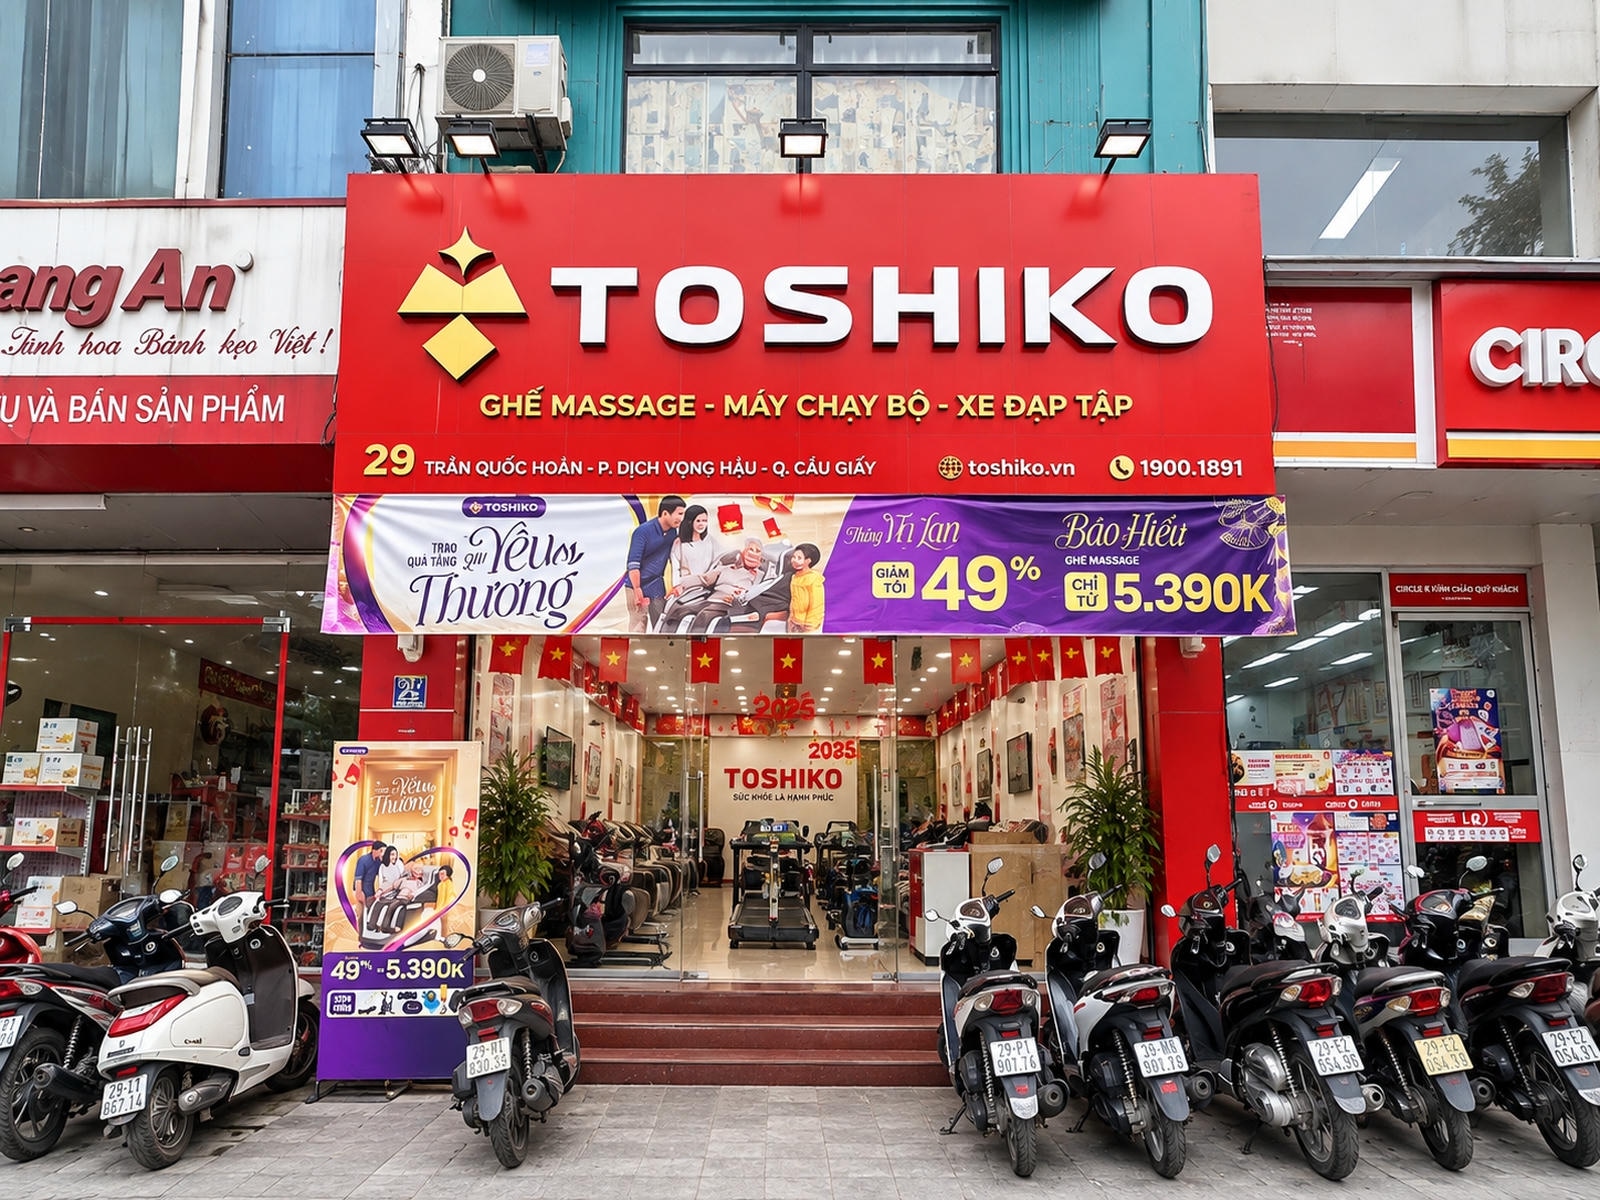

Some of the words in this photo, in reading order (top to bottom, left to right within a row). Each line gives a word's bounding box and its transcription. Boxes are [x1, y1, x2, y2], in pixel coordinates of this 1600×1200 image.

[120, 247, 236, 312] An
[549, 265, 1214, 351] TOSHIKO
[78, 331, 122, 356] hoa
[134, 327, 206, 356] Bánh
[219, 328, 258, 360] kẹo
[27, 387, 60, 423] VÀ
[68, 387, 128, 423] BÁN
[135, 386, 193, 423] SẢN
[201, 384, 285, 423] PHẨM
[480, 385, 545, 417] GHẾ
[551, 393, 696, 417] MASSAGE
[724, 389, 788, 417] MÁY
[797, 394, 879, 422] CHẠY
[887, 388, 930, 422] BỘ
[956, 394, 994, 417] XE
[1003, 394, 1068, 422] ĐẠP
[1075, 388, 1134, 422] TẬP
[363, 443, 416, 476] 29
[475, 455, 527, 477] QUỐC
[598, 461, 612, 475] P.
[617, 461, 659, 478] DỊCH
[772, 461, 789, 477] Q.
[967, 459, 1076, 476] toshiko.vn
[1140, 459, 1242, 476] 1900.1891
[484, 502, 538, 512] TOSHIKO
[431, 542, 457, 554] TRAO
[1088, 555, 1140, 566] MASSAGE
[1113, 571, 1273, 613] 5.390K
[724, 768, 843, 790] TOSHIKO
[385, 957, 465, 980] 5.390K
[103, 1093, 142, 1116] 867.14
